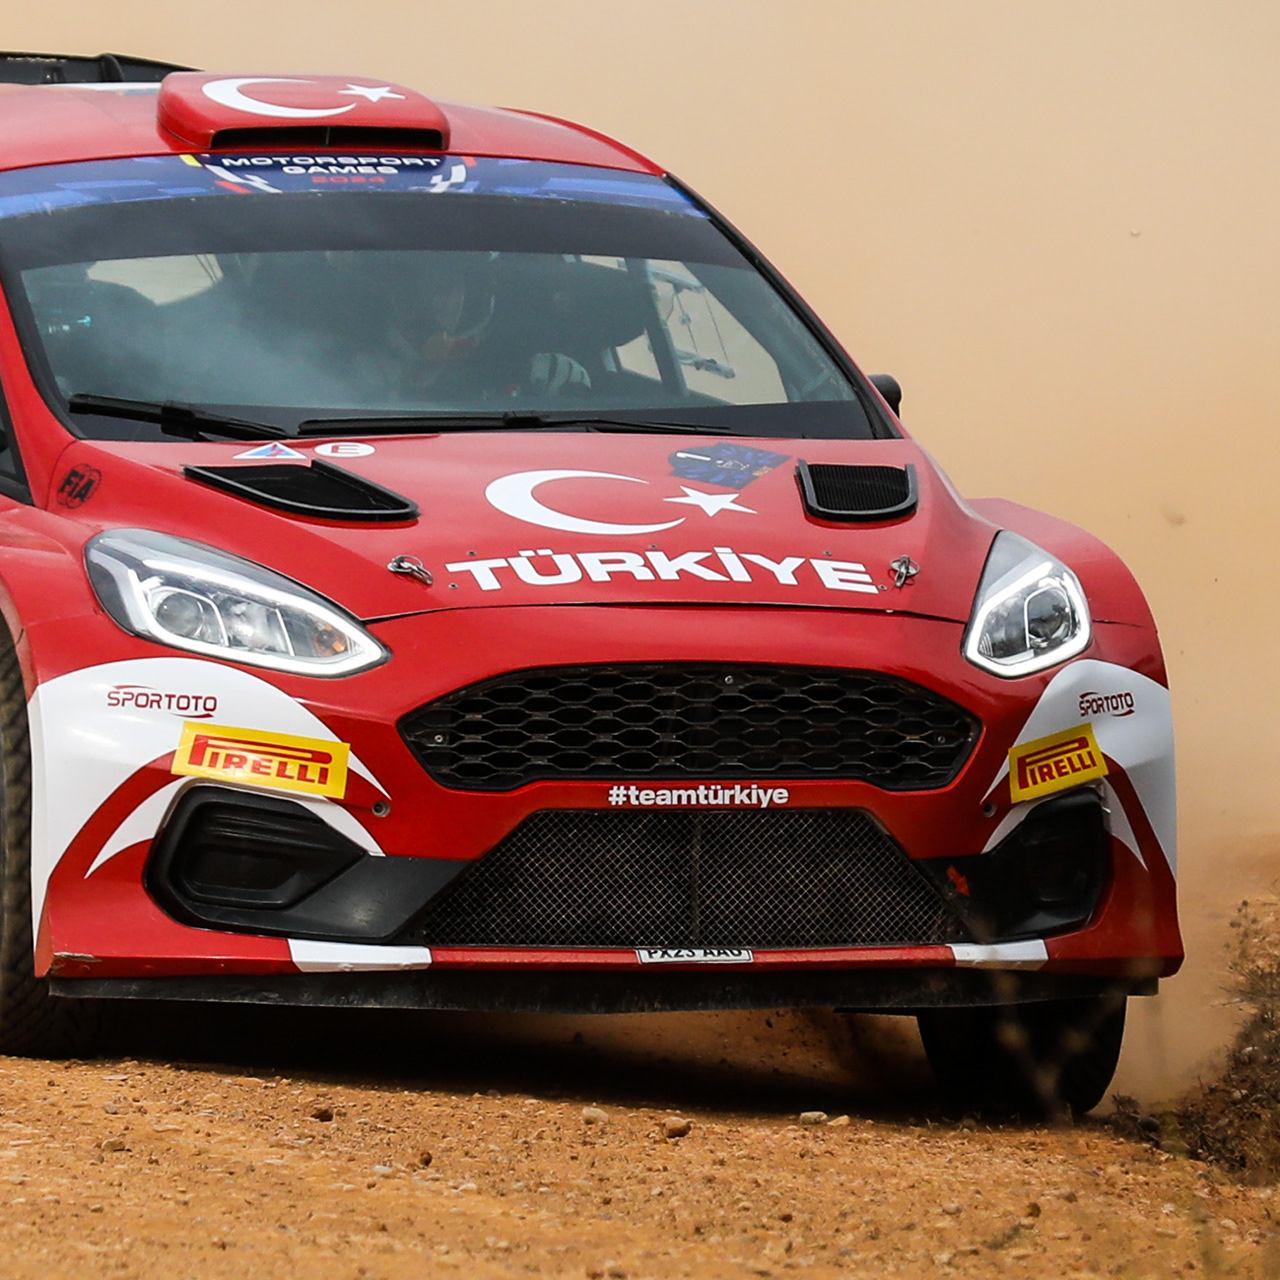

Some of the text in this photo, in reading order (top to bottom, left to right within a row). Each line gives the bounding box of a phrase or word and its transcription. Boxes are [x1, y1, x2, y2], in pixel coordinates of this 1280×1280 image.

[221, 156, 441, 167] MOTORSPORT
[282, 166, 399, 175] GAMES
[59, 469, 96, 503] FIA
[445, 546, 880, 595] TÜRKİYE
[188, 734, 333, 786] PIRELLI
[1017, 736, 1098, 790] PIRELLI
[608, 785, 789, 809] #teamtürkiye
